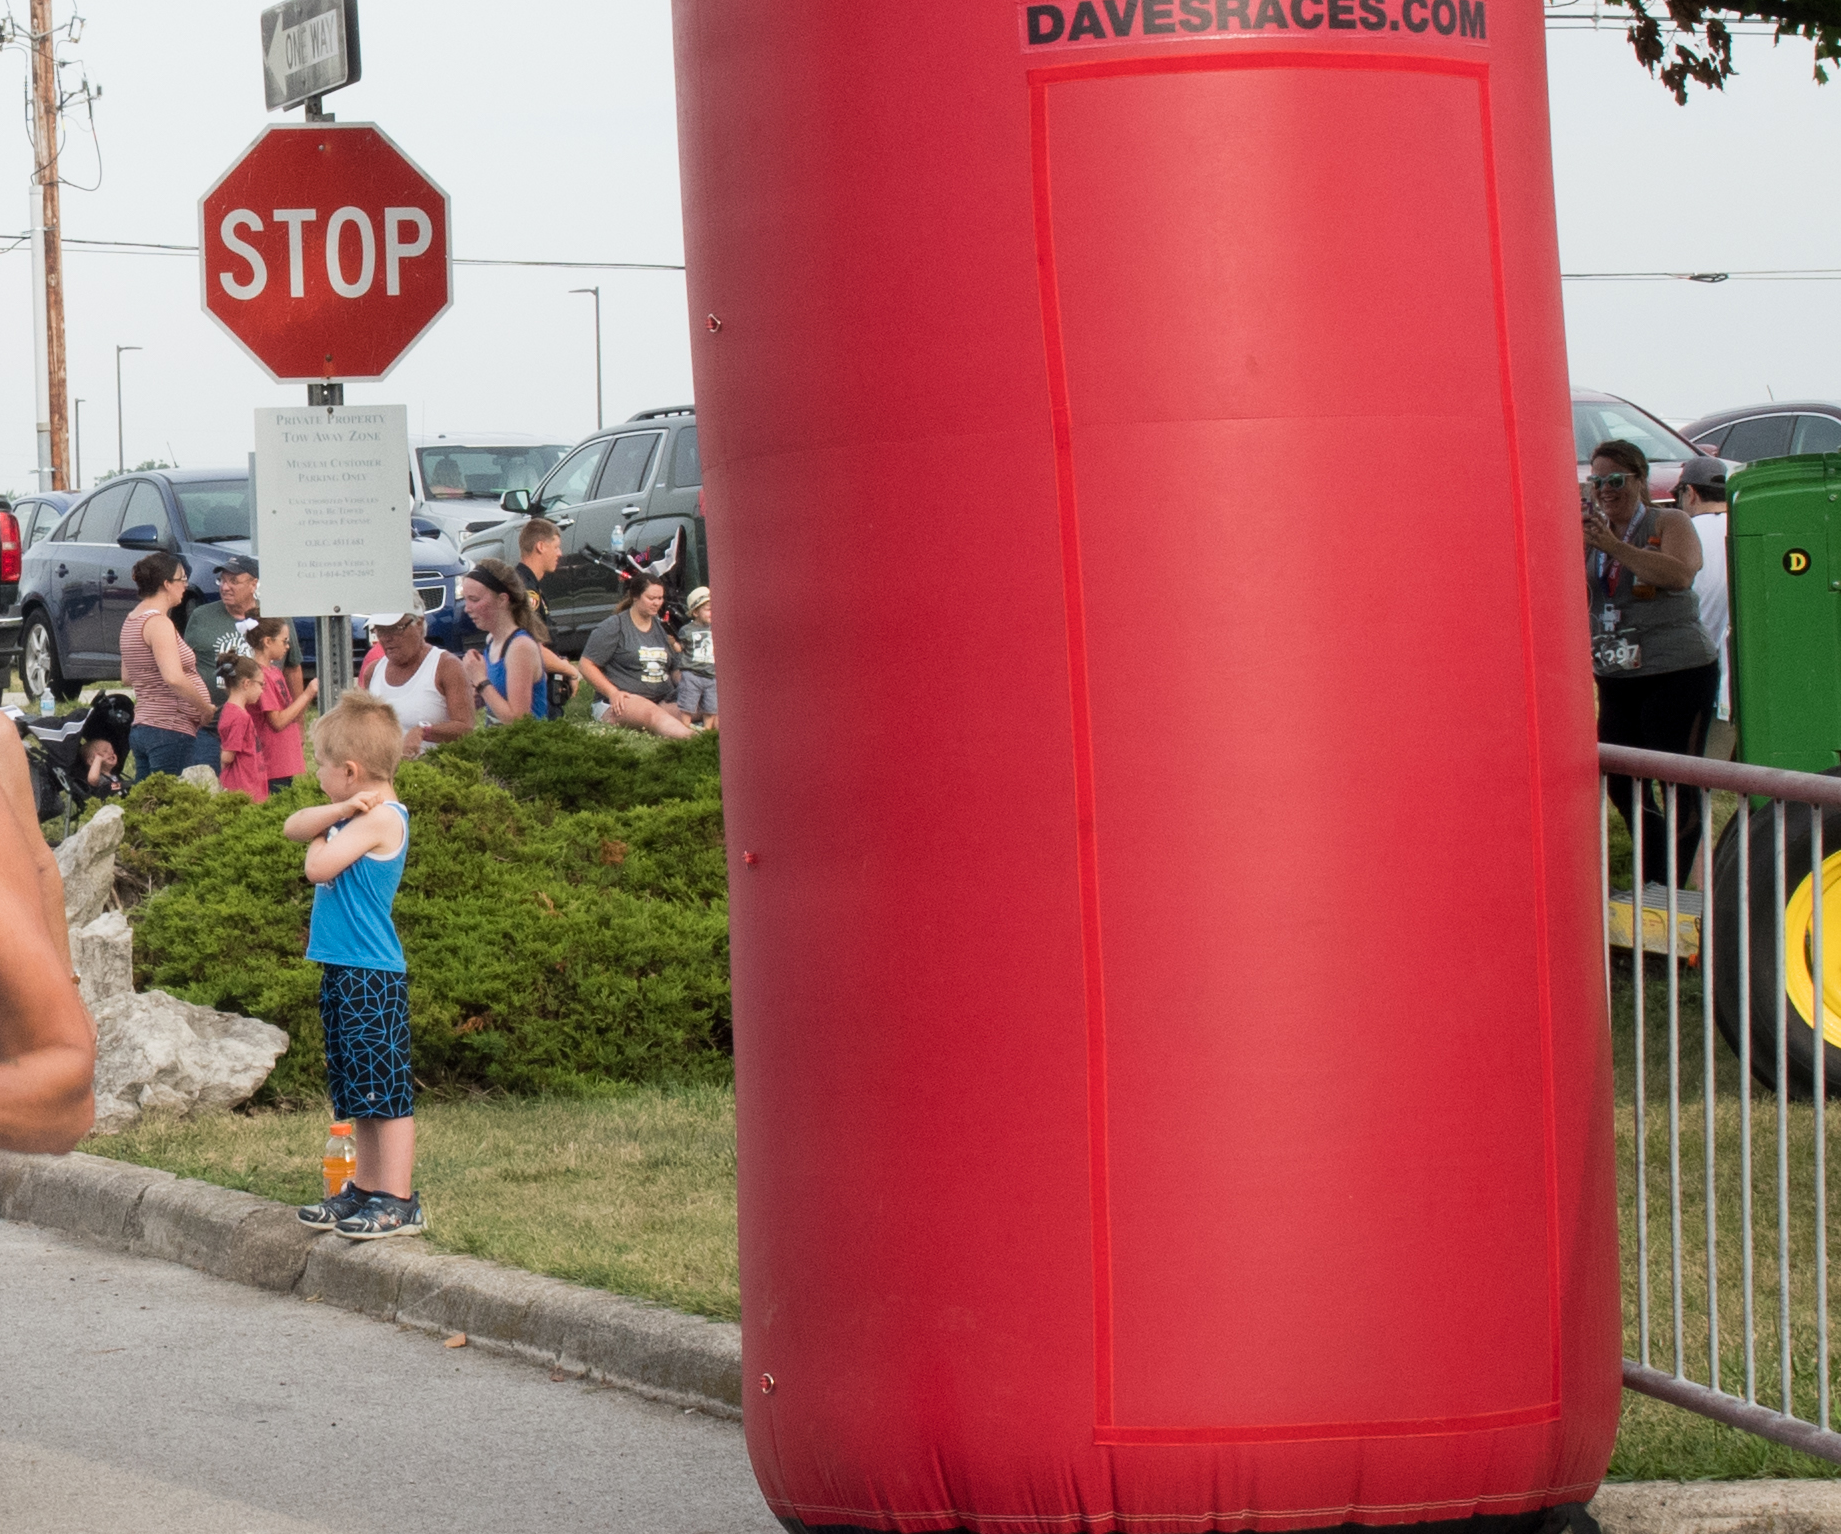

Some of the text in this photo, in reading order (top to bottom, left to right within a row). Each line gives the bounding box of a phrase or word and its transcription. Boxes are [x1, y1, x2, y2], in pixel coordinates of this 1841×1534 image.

[285, 13, 335, 70] ONE WAY
[219, 205, 433, 300] STOP
[327, 413, 385, 425] PROPERTY
[349, 430, 381, 442] ZONE
[1789, 553, 1806, 571] D
